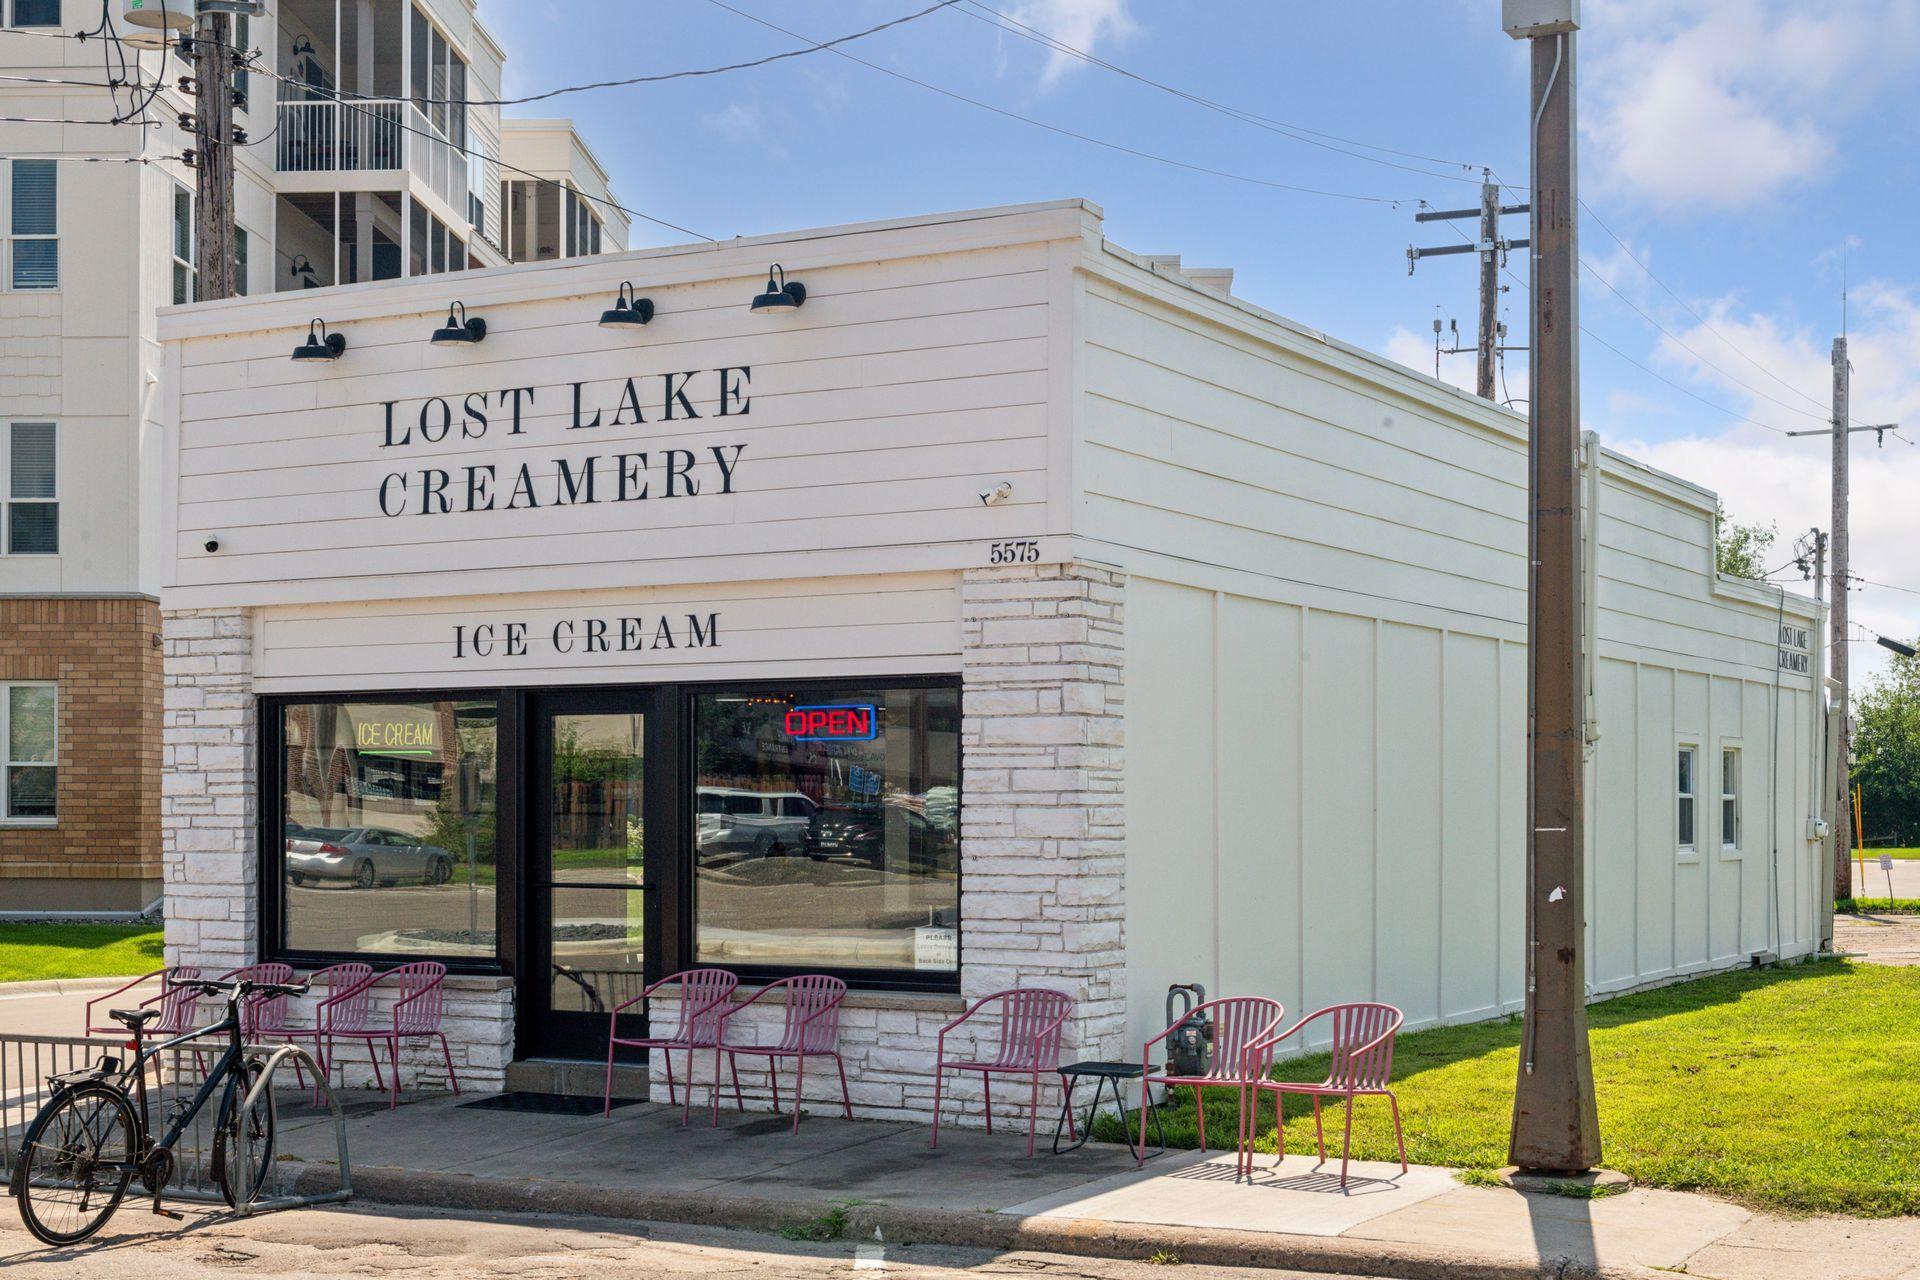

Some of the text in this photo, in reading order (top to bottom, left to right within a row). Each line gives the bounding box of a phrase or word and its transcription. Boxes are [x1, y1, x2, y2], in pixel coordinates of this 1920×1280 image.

[378, 365, 752, 448] LOST LAKE
[378, 443, 749, 518] CREAMERY
[990, 540, 1040, 565] 5575
[452, 612, 723, 659] ICE CREAM
[1793, 629, 1807, 649] LAKE
[358, 722, 433, 746] ICE CREAM
[785, 710, 868, 735] OPEN
